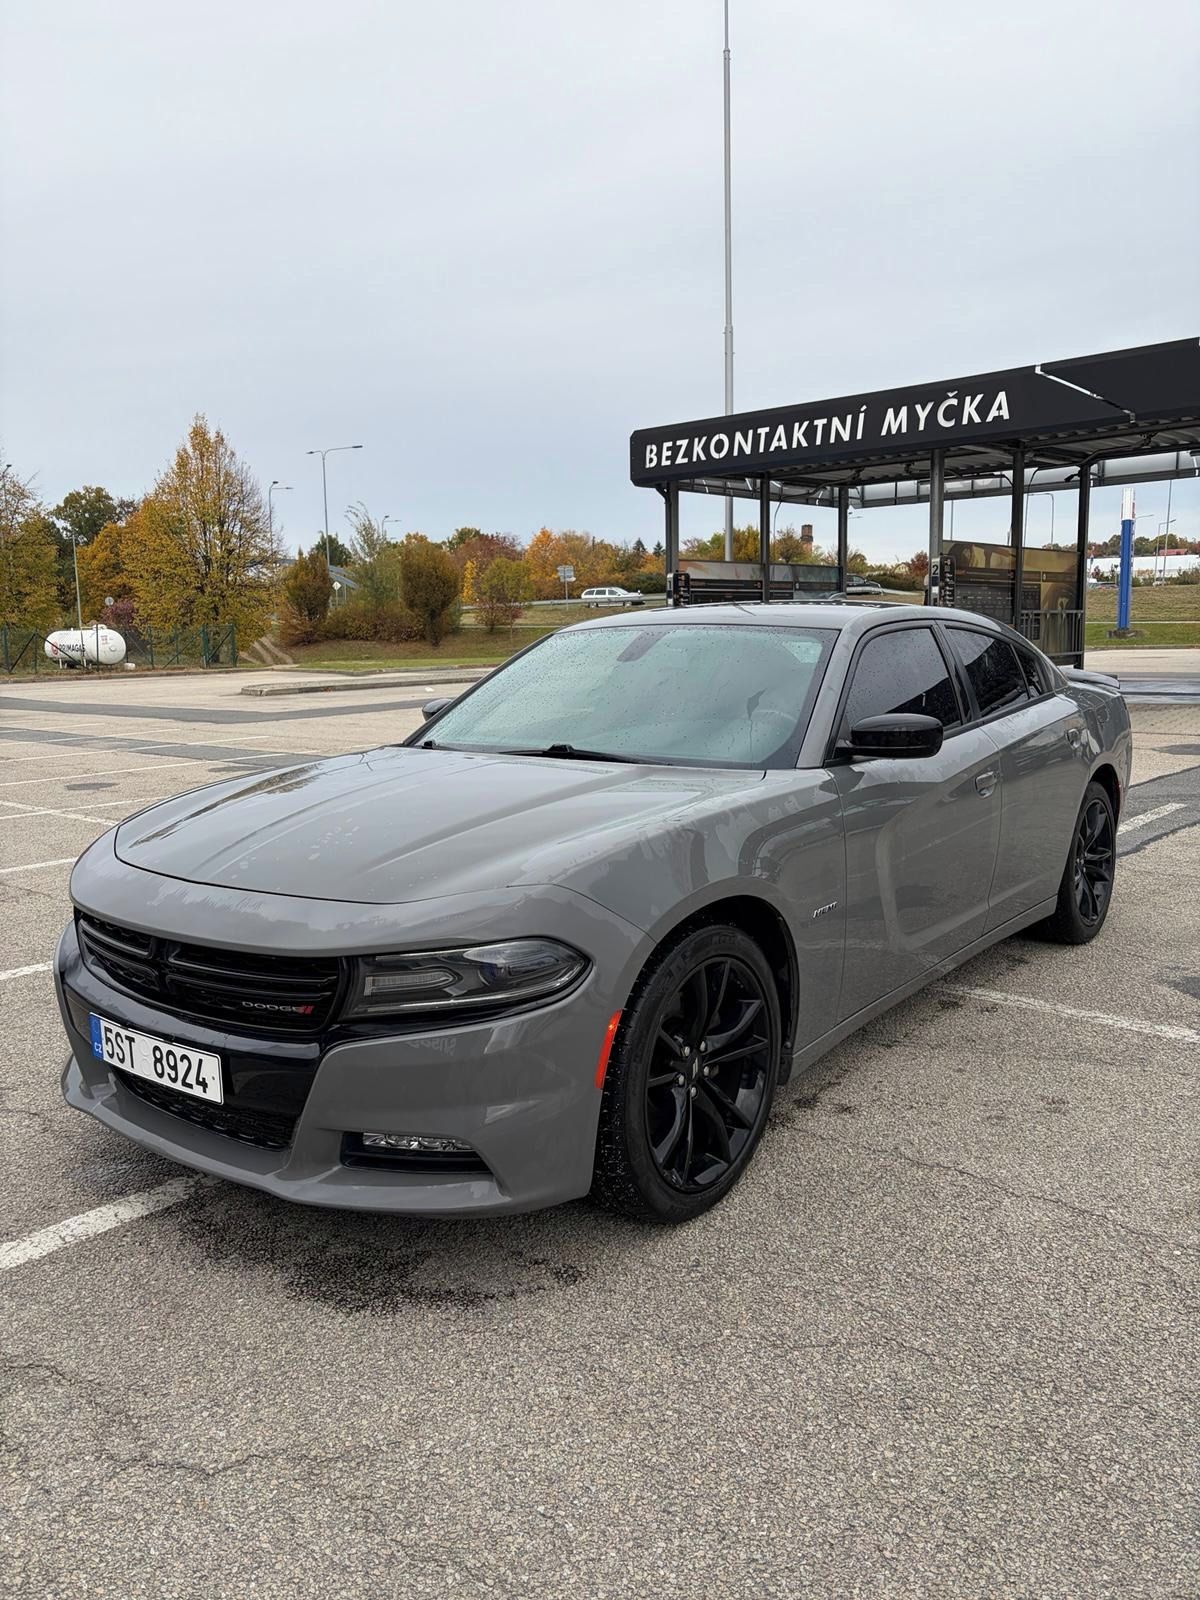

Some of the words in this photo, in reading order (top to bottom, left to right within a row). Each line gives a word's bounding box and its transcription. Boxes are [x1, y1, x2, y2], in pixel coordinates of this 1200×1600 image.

[645, 404, 868, 469] BEZKONTAKTNÍ
[880, 390, 1010, 437] MYČKA
[932, 564, 939, 575] 2
[242, 1001, 303, 1014] DODGE
[103, 1025, 136, 1069] 5ST
[153, 1045, 209, 1094] 8924
